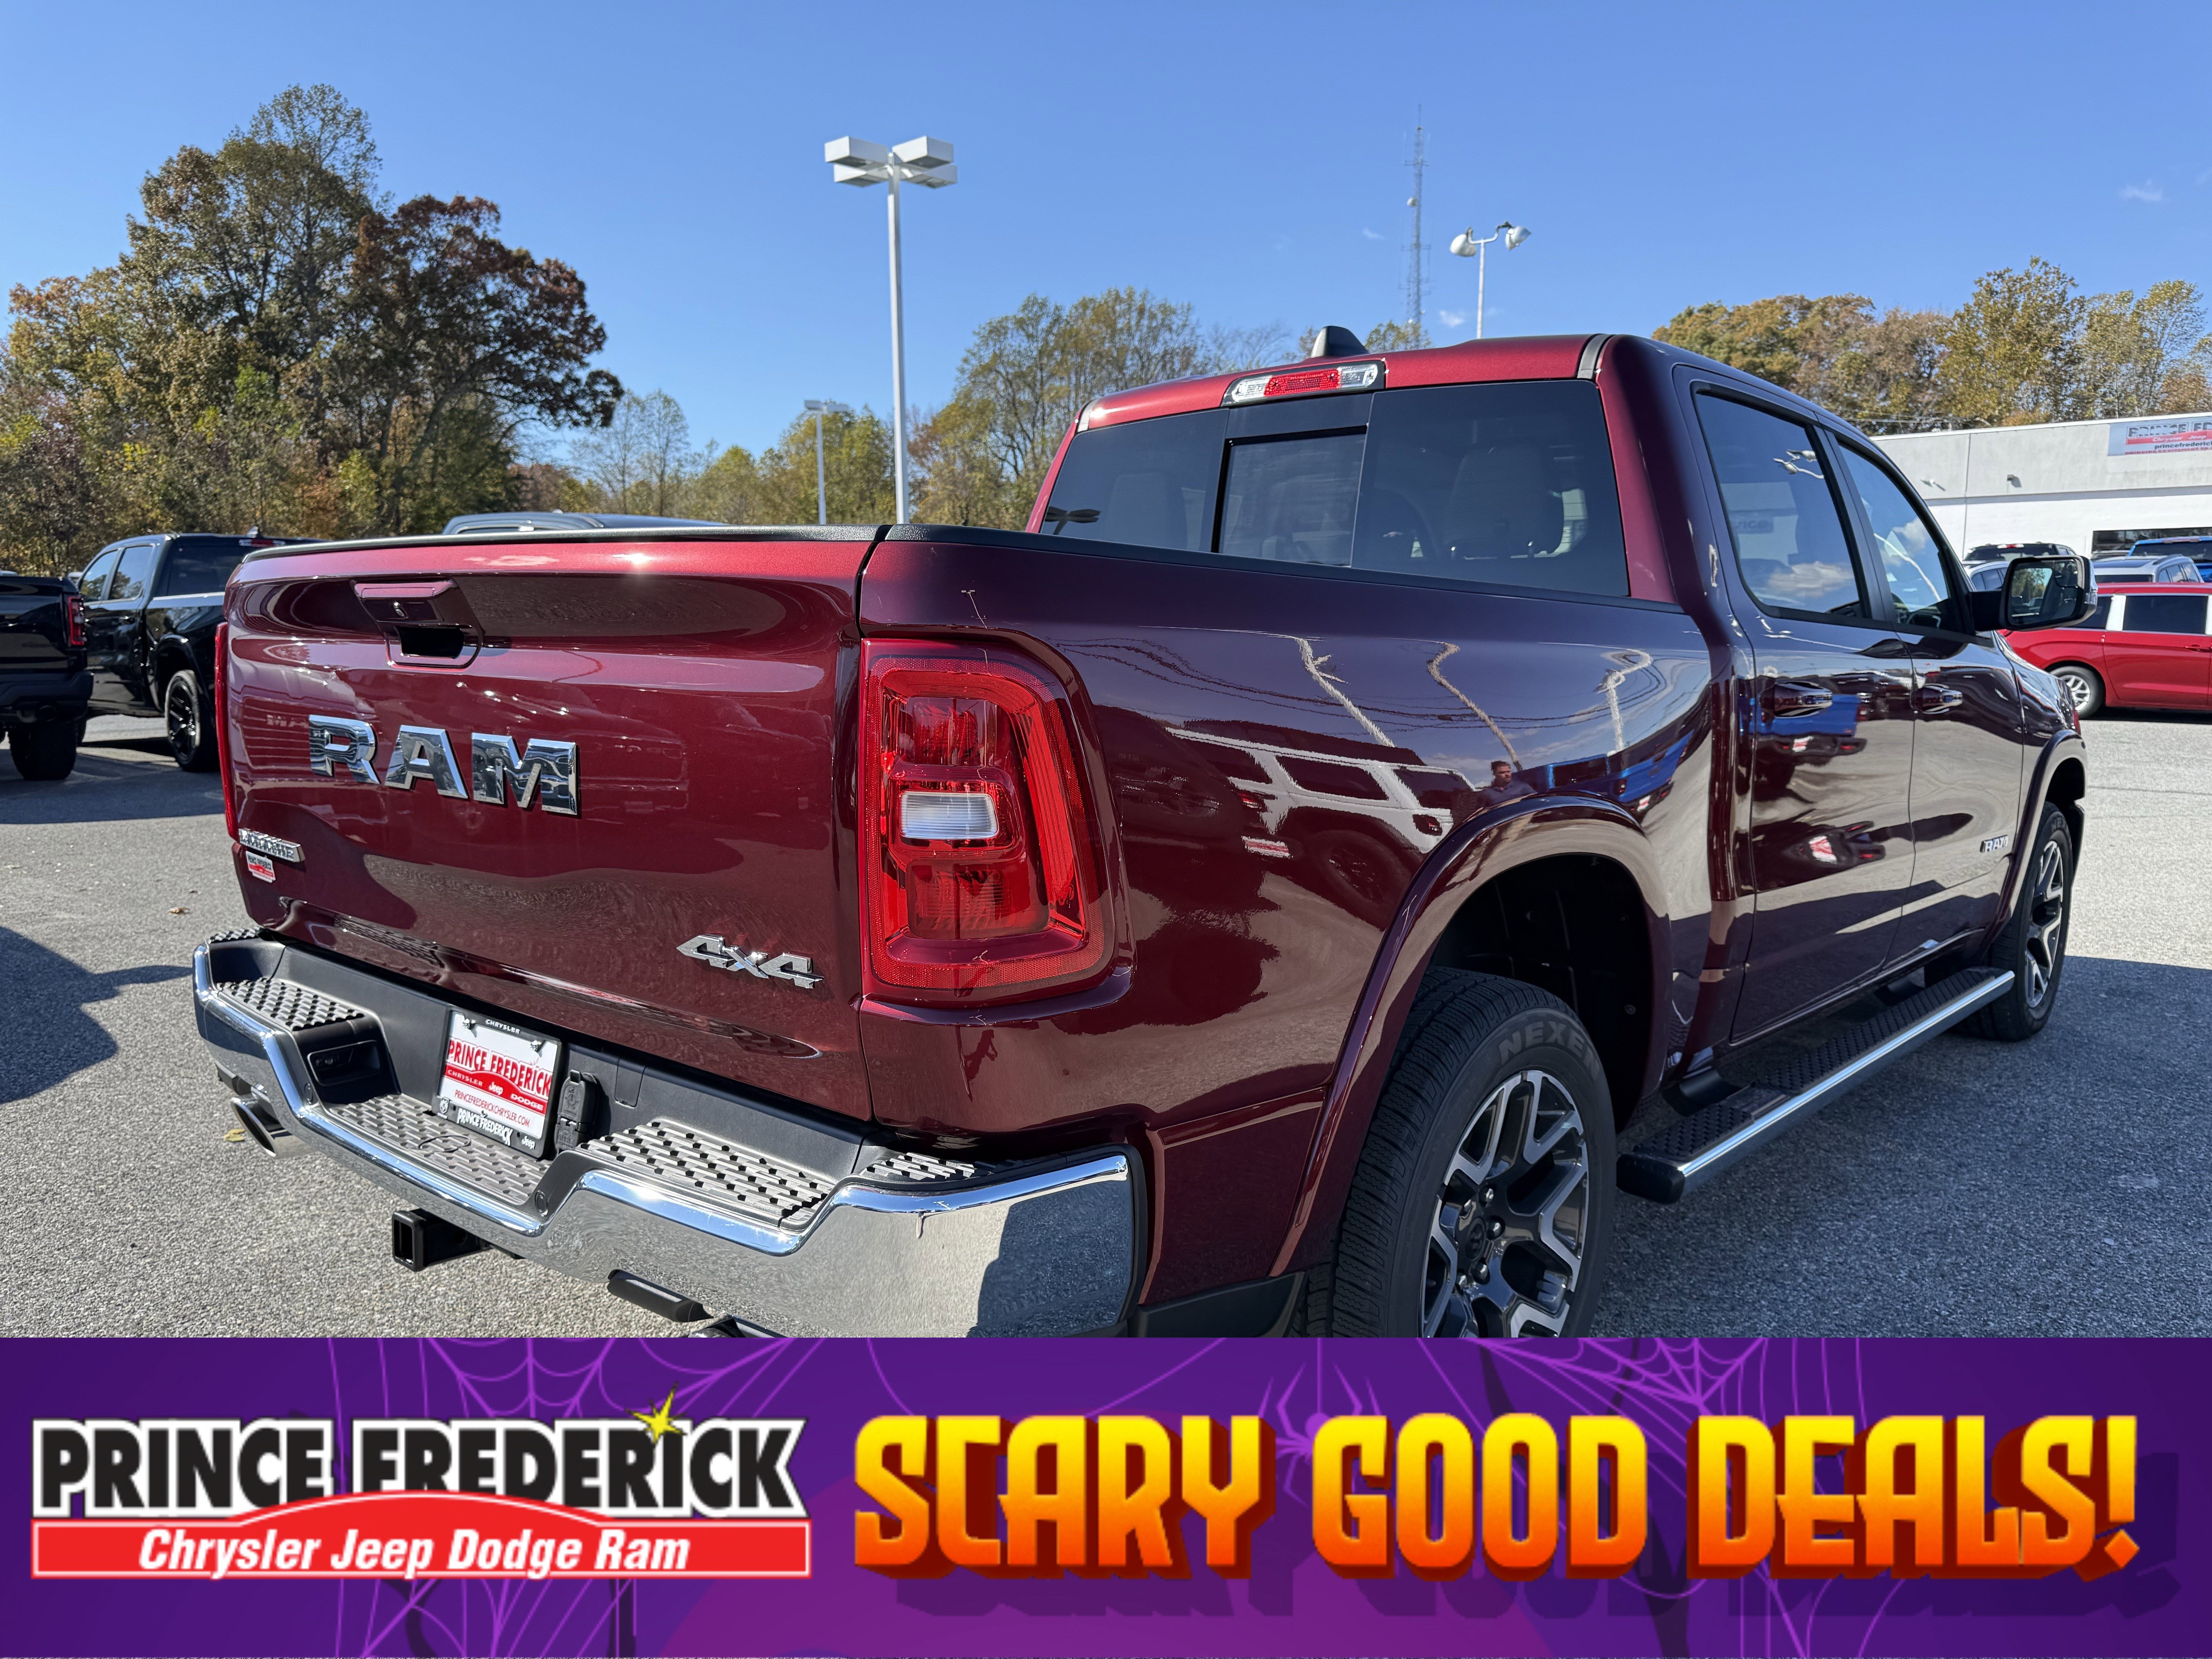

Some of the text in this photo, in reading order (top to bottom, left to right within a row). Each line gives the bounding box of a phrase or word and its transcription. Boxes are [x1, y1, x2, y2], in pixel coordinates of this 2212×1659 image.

[309, 714, 579, 816] RAM
[1980, 835, 2009, 853] RAM
[485, 1018, 520, 1034] CHRYSLER
[448, 1038, 553, 1097] PRINCE FREDERICK
[1498, 1020, 1601, 1081] NEXEN
[447, 1069, 544, 1111] CHRYSLER Jeep DODGE
[454, 1089, 530, 1127] PRINCEFREDERICKCHRYSLER.COM
[457, 1108, 513, 1146] PRINCE FREDERICK
[521, 1135, 536, 1150] Jeep
